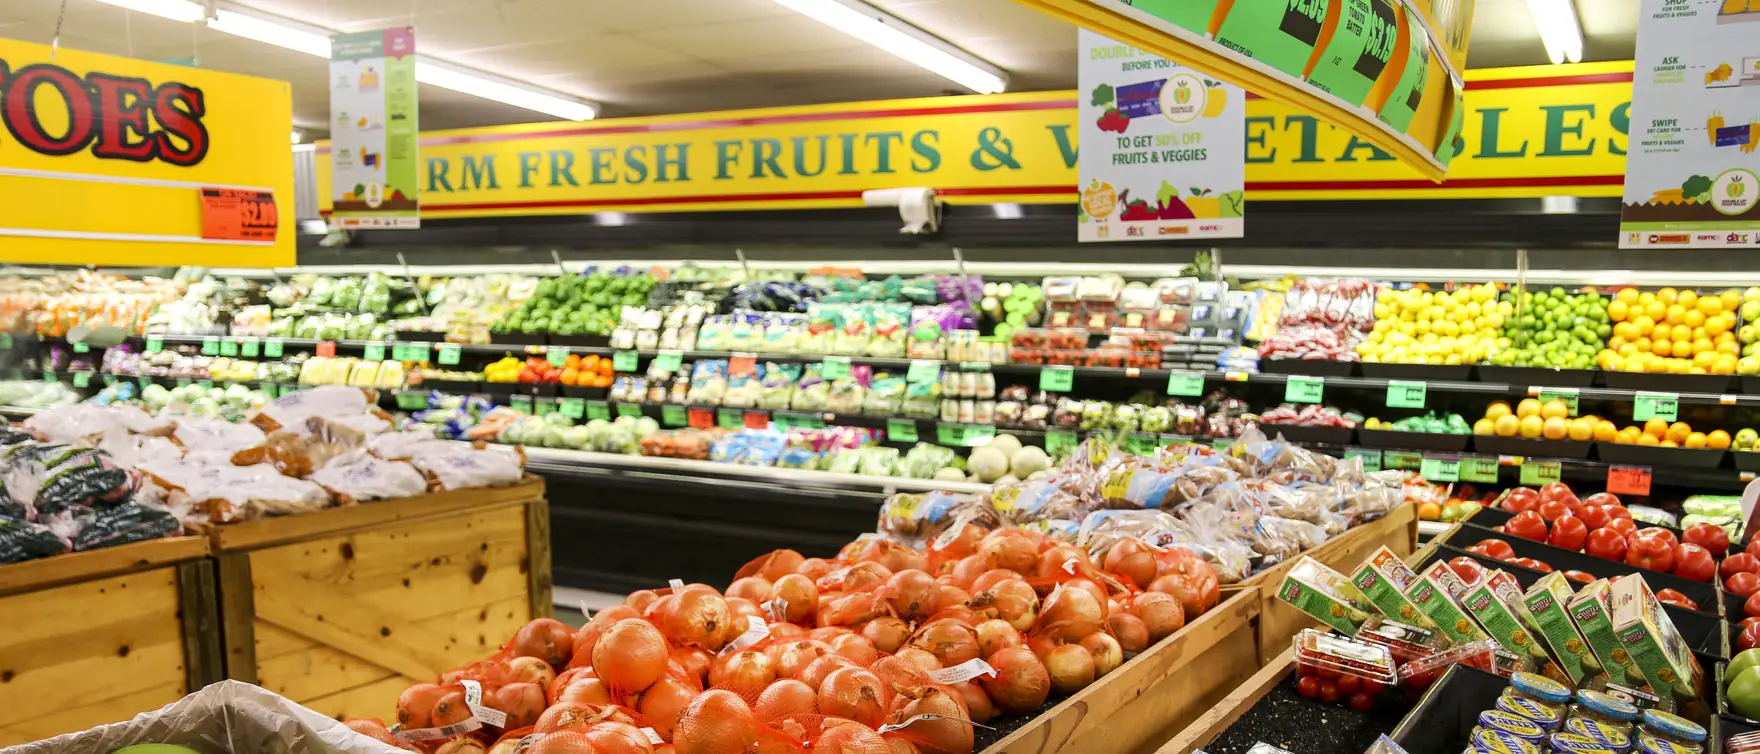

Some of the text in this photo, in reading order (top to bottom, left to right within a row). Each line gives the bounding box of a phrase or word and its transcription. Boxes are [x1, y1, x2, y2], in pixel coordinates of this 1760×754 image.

[1349, 6, 1365, 25] TOMATO
[1346, 19, 1362, 37] BATTER
[1364, 10, 1396, 63] $3.19
[1091, 45, 1135, 60] DOUBLE
[1218, 36, 1239, 52] PRODUCT
[1122, 60, 1152, 71] BEFORE
[1154, 59, 1171, 69] YOU
[1662, 56, 1679, 65] ASK
[0, 57, 209, 167] OES
[1652, 118, 1678, 128] SWIPE
[1116, 131, 1204, 149] TO GET 50% OFF
[420, 153, 501, 194] RM
[516, 142, 693, 189] FRESH
[712, 128, 942, 181] FRUITS
[969, 126, 1023, 172] &
[1112, 148, 1207, 165] FRUITS & VEGGIES
